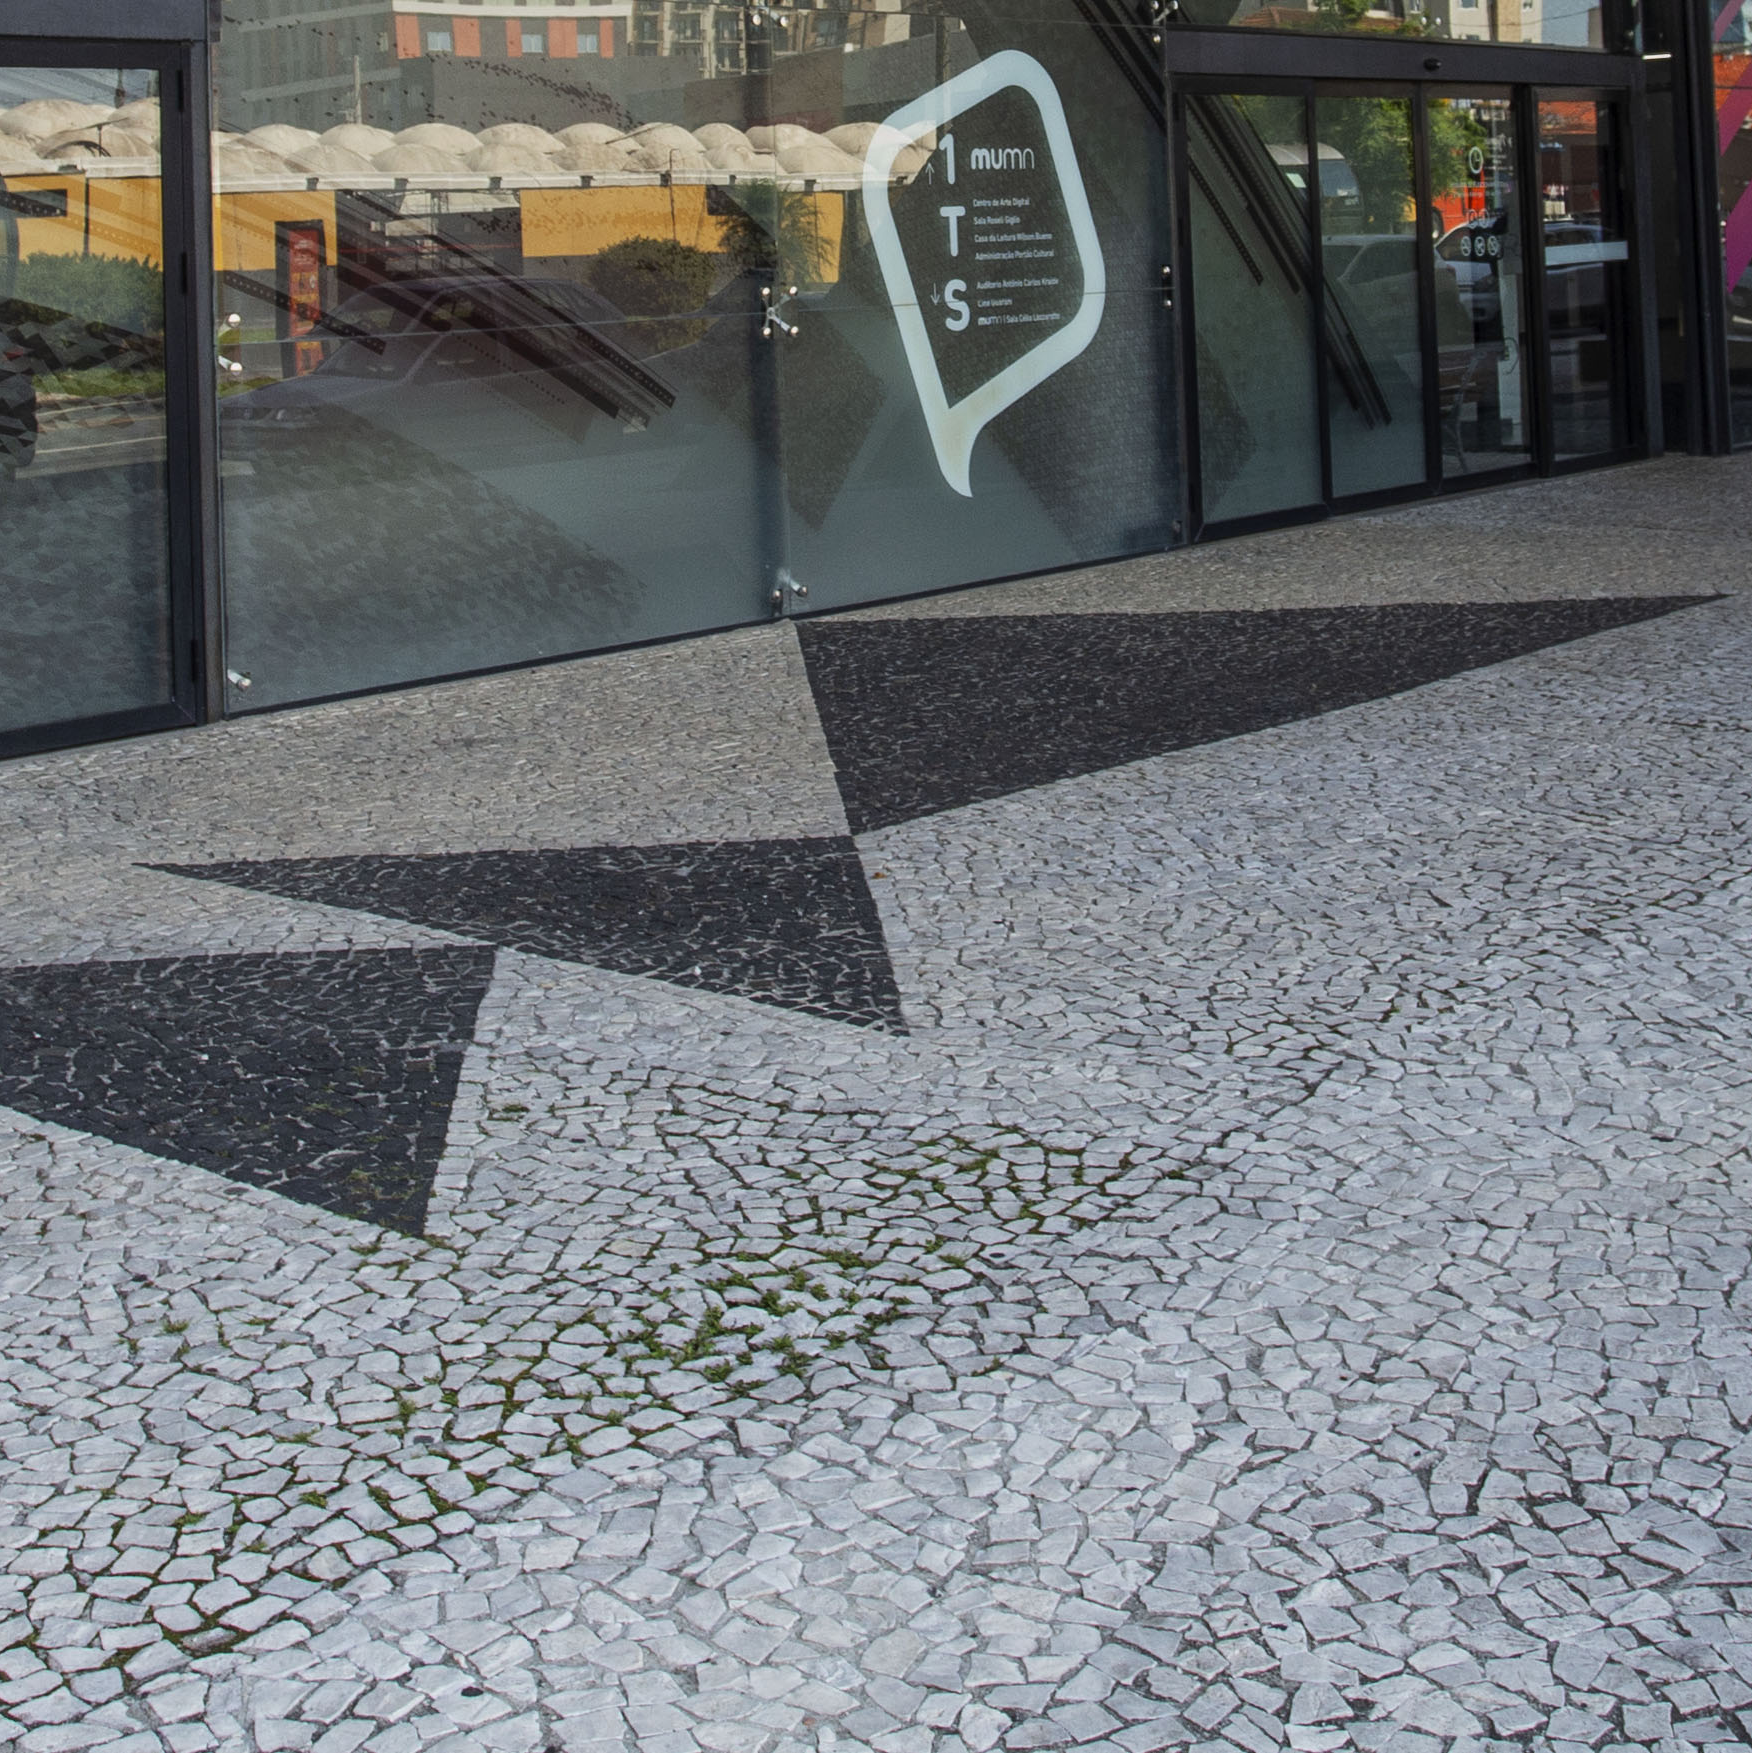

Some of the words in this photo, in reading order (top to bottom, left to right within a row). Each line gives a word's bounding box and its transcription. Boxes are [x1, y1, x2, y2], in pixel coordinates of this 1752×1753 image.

[939, 133, 956, 185] 1
[973, 198, 991, 207] Centro
[1000, 198, 1012, 206] Arte
[1012, 198, 1030, 207] Digital
[974, 216, 986, 225] Sala
[939, 206, 966, 257] T
[974, 234, 988, 242] Casa
[997, 234, 1016, 242] Leitura
[1015, 250, 1033, 258] Portão
[1033, 249, 1054, 258] Cultural
[944, 279, 970, 331] S
